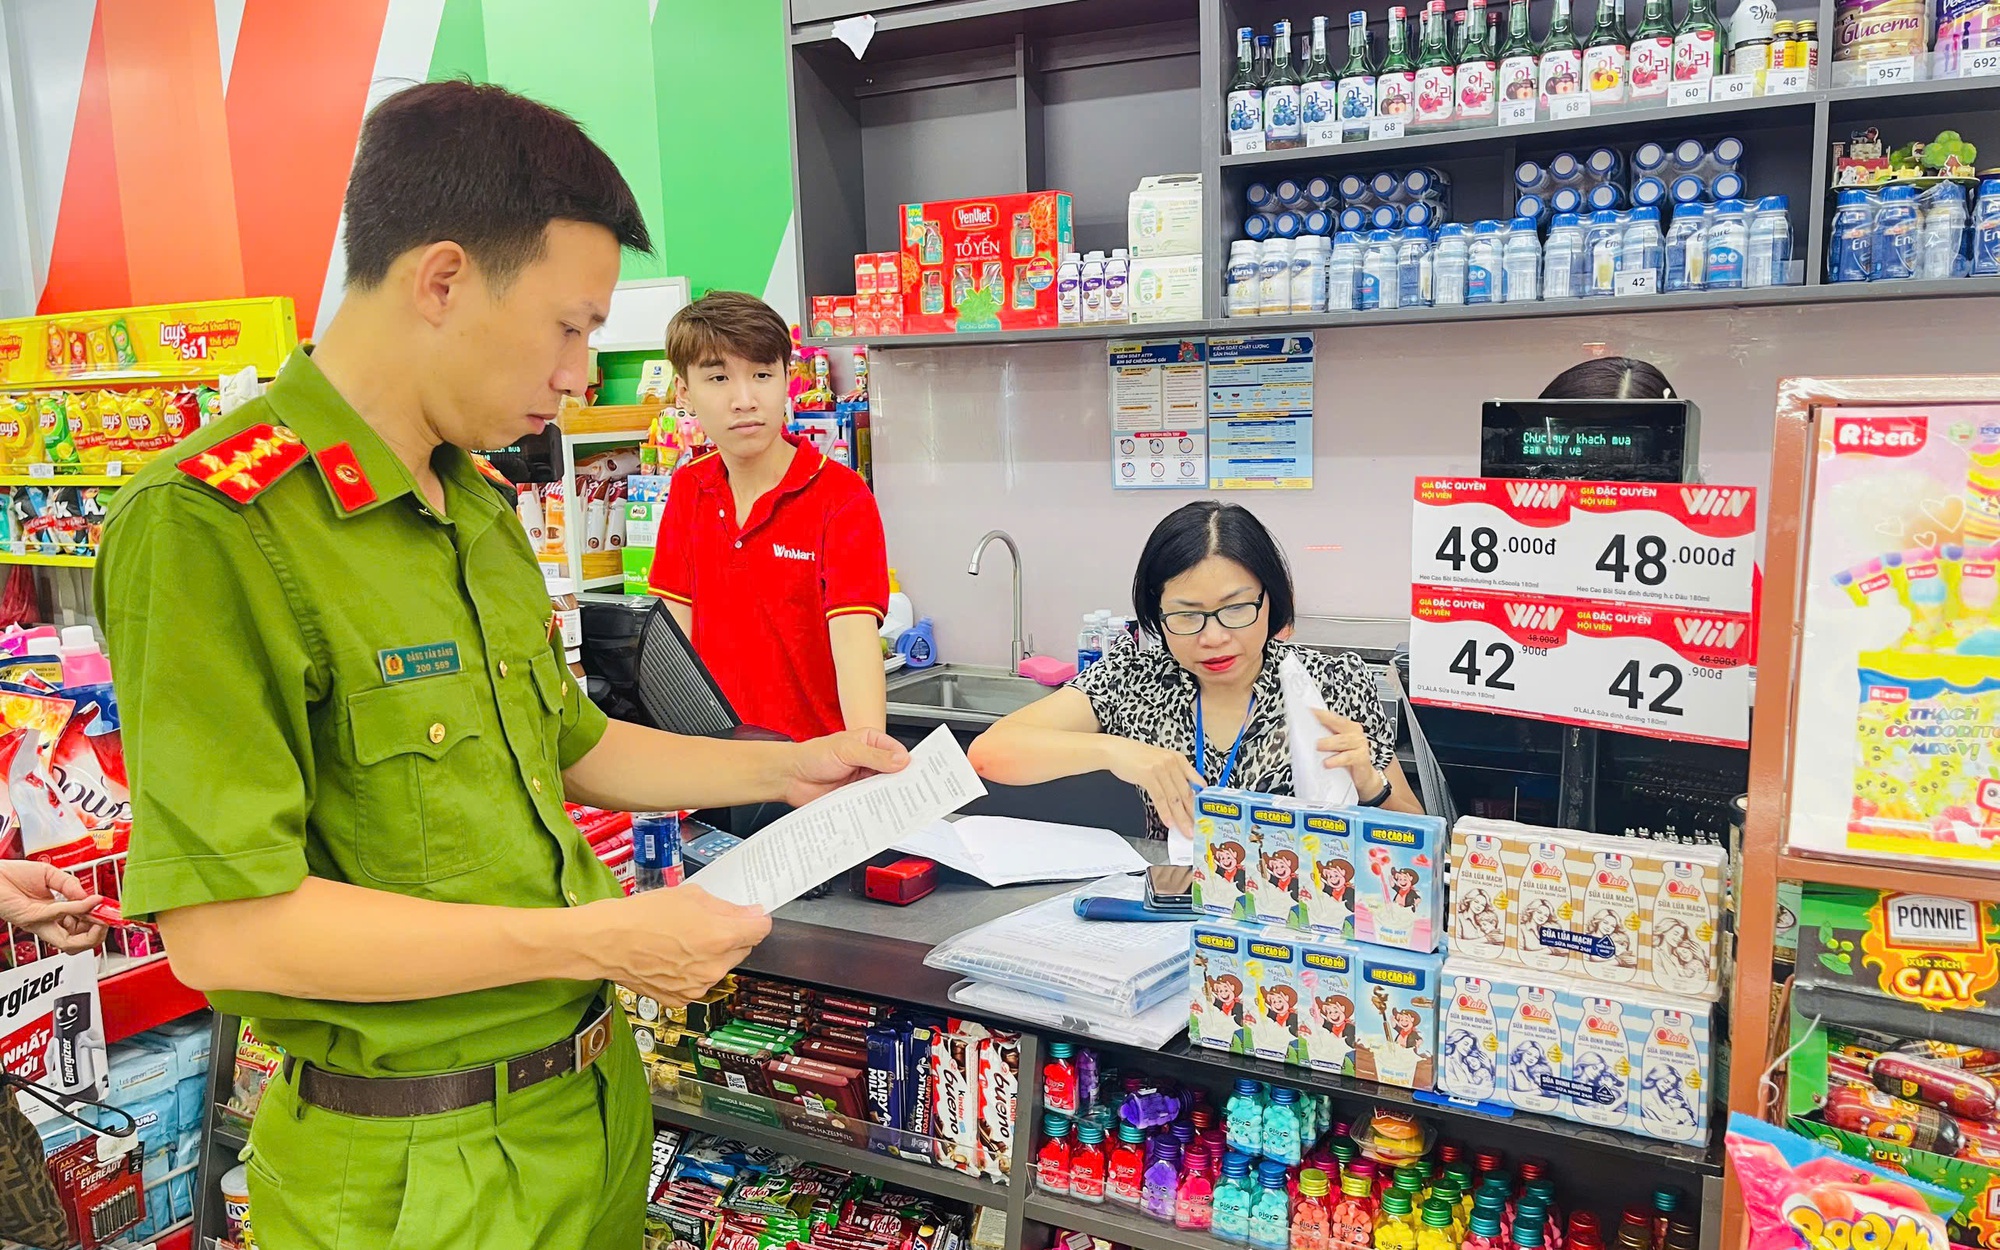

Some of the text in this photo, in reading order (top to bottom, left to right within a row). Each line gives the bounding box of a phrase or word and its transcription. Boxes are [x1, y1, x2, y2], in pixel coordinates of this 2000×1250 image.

[1841, 17, 1919, 46] Glucerna
[1973, 57, 1997, 68] 692
[1879, 67, 1901, 78] 957
[1729, 82, 1743, 92] 60
[1783, 77, 1797, 86] 48
[1685, 88, 1699, 98] 60
[1513, 109, 1525, 117] 68
[1566, 102, 1579, 111] 68
[1384, 123, 1395, 131] 68
[1322, 131, 1333, 139] 63
[1246, 141, 1257, 150] 63
[958, 207, 991, 225] YenViet
[955, 235, 1000, 257] TỔ YẾN
[1632, 276, 1646, 288] 42
[160, 322, 186, 348] Lay's
[182, 336, 207, 358] Số 1
[1576, 433, 1606, 445] khach
[1839, 423, 1922, 446] Risen
[1569, 447, 1581, 455] ve
[1435, 480, 1452, 491] ĐẶC
[1455, 480, 1486, 491] QUYỀN
[1596, 487, 1617, 498] ĐẶC
[1619, 486, 1657, 497] QUYỀN
[1435, 491, 1452, 499] VIÊN
[1580, 498, 1617, 507] HỘI VIÊN
[773, 543, 815, 561] WinMart
[1435, 526, 1498, 573] 48
[1595, 534, 1667, 586] 48
[1433, 598, 1451, 609] ĐẶC
[1453, 599, 1485, 610] QUYỀN
[1592, 612, 1612, 623] ĐẶC
[1615, 612, 1651, 625] QUYỀN
[1577, 622, 1612, 631] HỘI VIÊN
[416, 663, 431, 673] 200
[1449, 640, 1515, 691] 42
[1608, 659, 1683, 716] 42
[1897, 904, 1967, 930] PÖNNIE
[1542, 928, 1593, 946] SỮA LÚA MẠCH
[1251, 945, 1264, 955] HEO
[1265, 946, 1277, 958] CAO
[1306, 955, 1319, 964] HEO
[1320, 955, 1332, 967] CAO
[1908, 958, 1961, 969] XÚC XÍCH
[1372, 969, 1387, 981] HEO
[1387, 970, 1402, 983] CAO
[1893, 968, 1976, 1000] CAY
[3, 1028, 50, 1067] NHẤT
[64, 1038, 76, 1085] Energizer
[717, 1051, 763, 1066] SELECTION
[868, 1067, 877, 1100] MILK
[877, 1070, 887, 1115] DAIRY
[915, 1073, 927, 1133] DAIRY MILK
[944, 1069, 959, 1135] bueno
[994, 1072, 1010, 1138] bueno
[75, 1165, 91, 1177] AAA
[80, 1160, 122, 1190] EVEREADY
[741, 1187, 769, 1198] KitKat
[872, 1216, 900, 1233] KitKat
